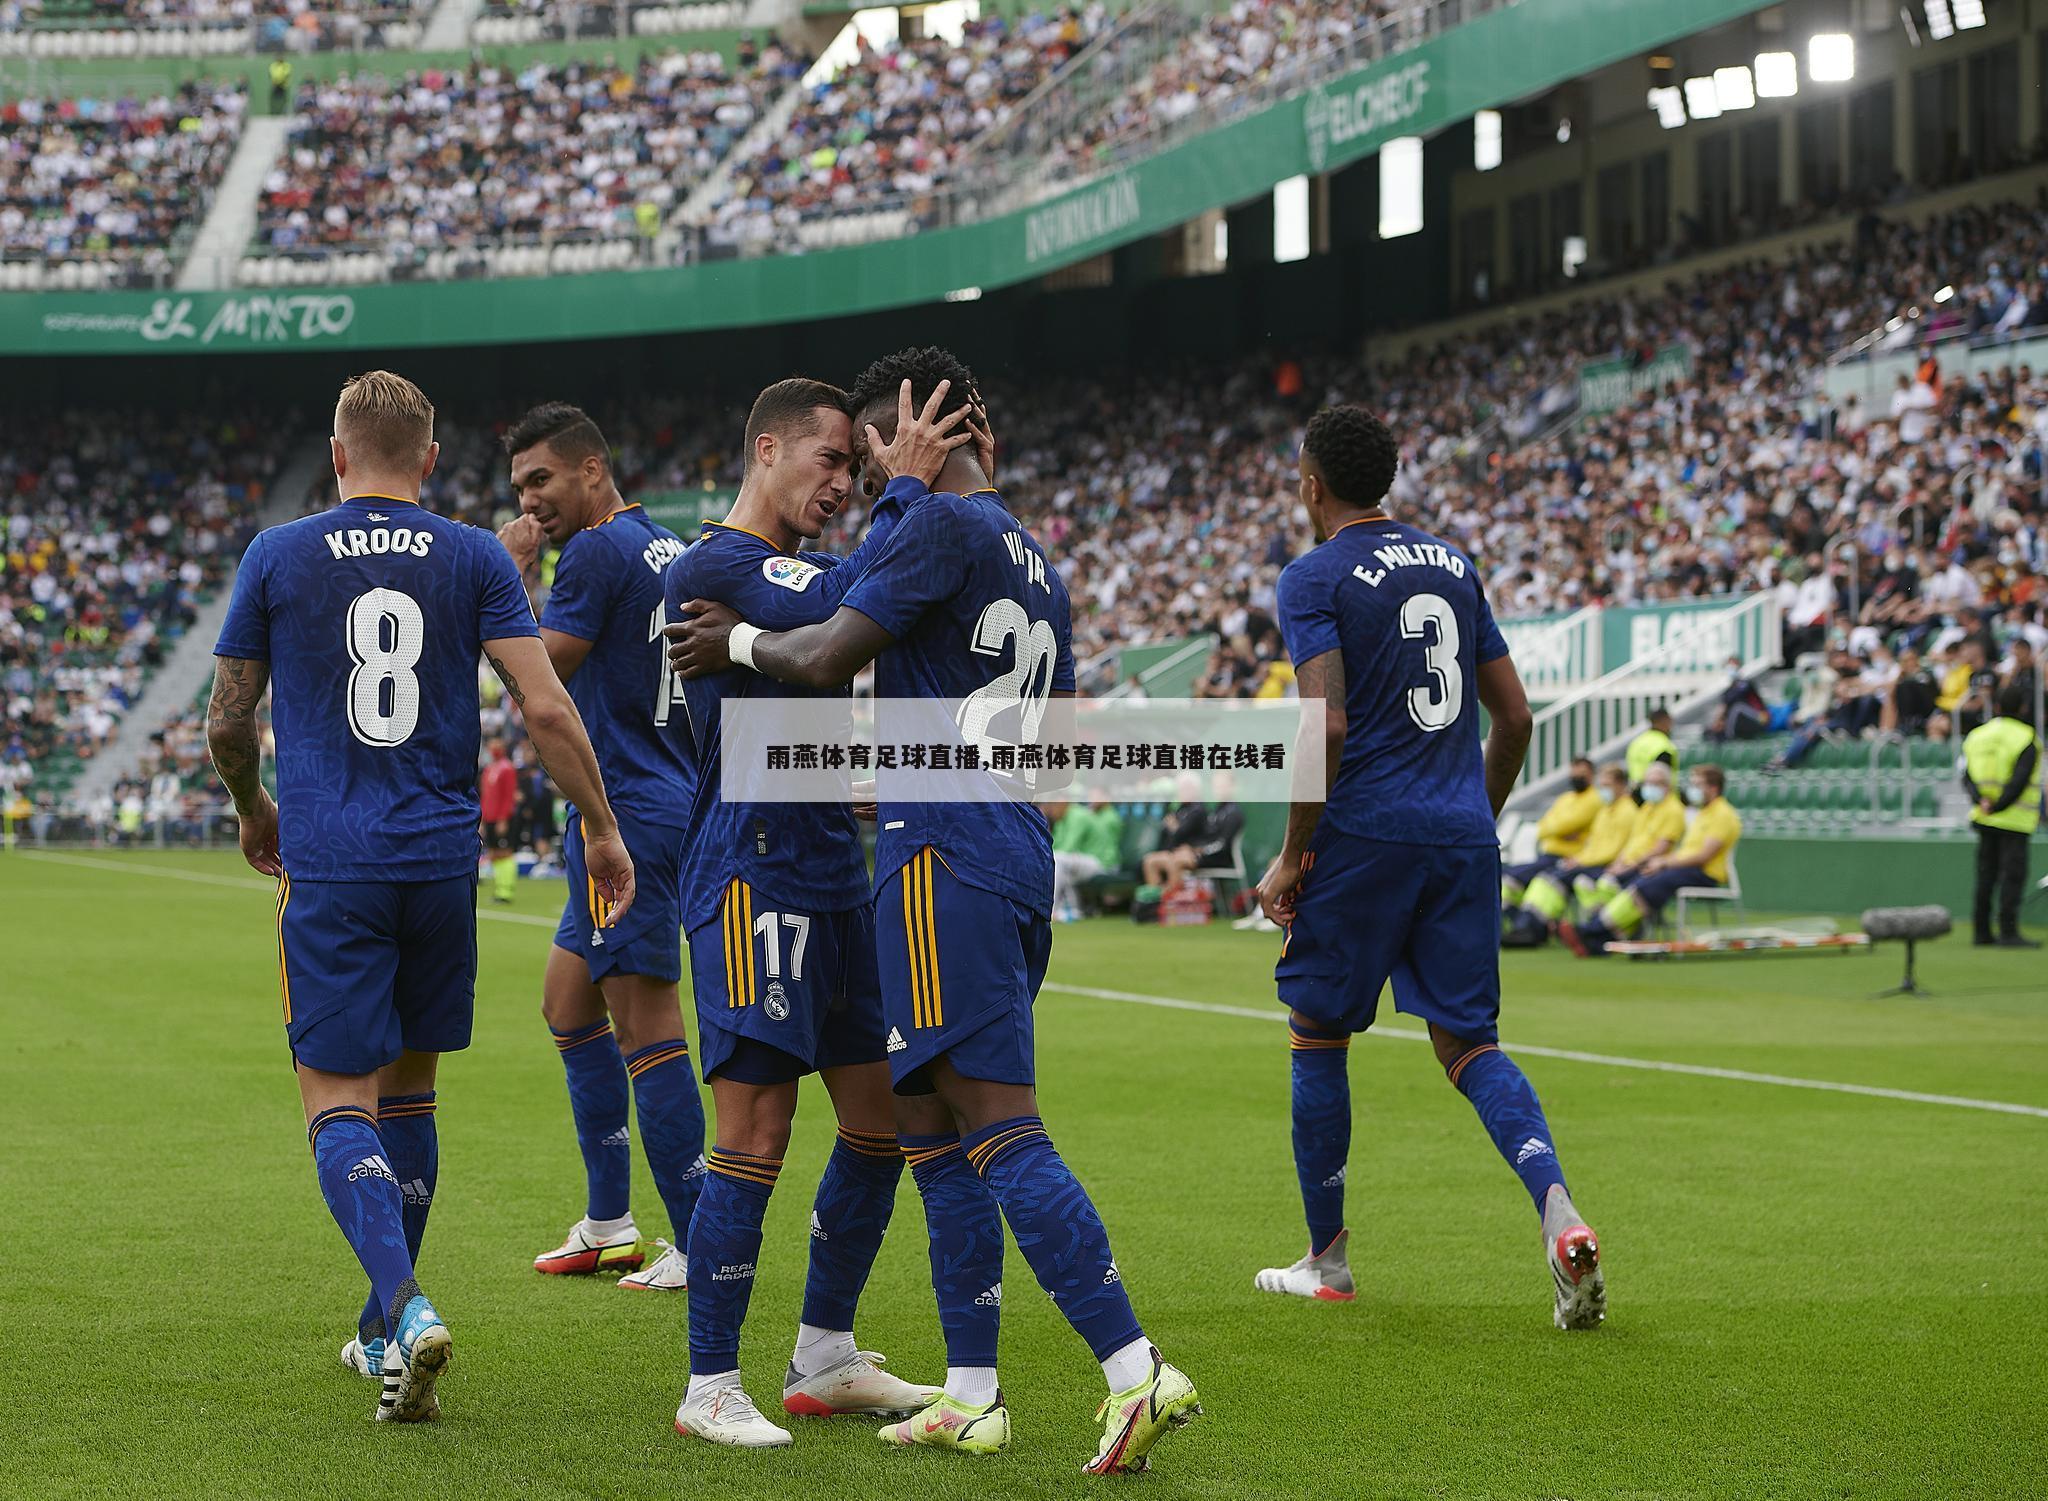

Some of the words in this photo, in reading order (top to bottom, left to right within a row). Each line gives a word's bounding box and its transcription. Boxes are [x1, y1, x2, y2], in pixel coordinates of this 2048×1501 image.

[140, 298, 196, 341] EL
[324, 528, 434, 560] KROOS
[1353, 564, 1387, 588] E.
[1373, 544, 1465, 579] MILITÃO
[346, 587, 424, 747] 8
[1400, 593, 1463, 732] 3
[955, 598, 1057, 790] 20
[753, 911, 810, 981] 17
[347, 1167, 400, 1187] adidas
[720, 1262, 755, 1275] REAL
